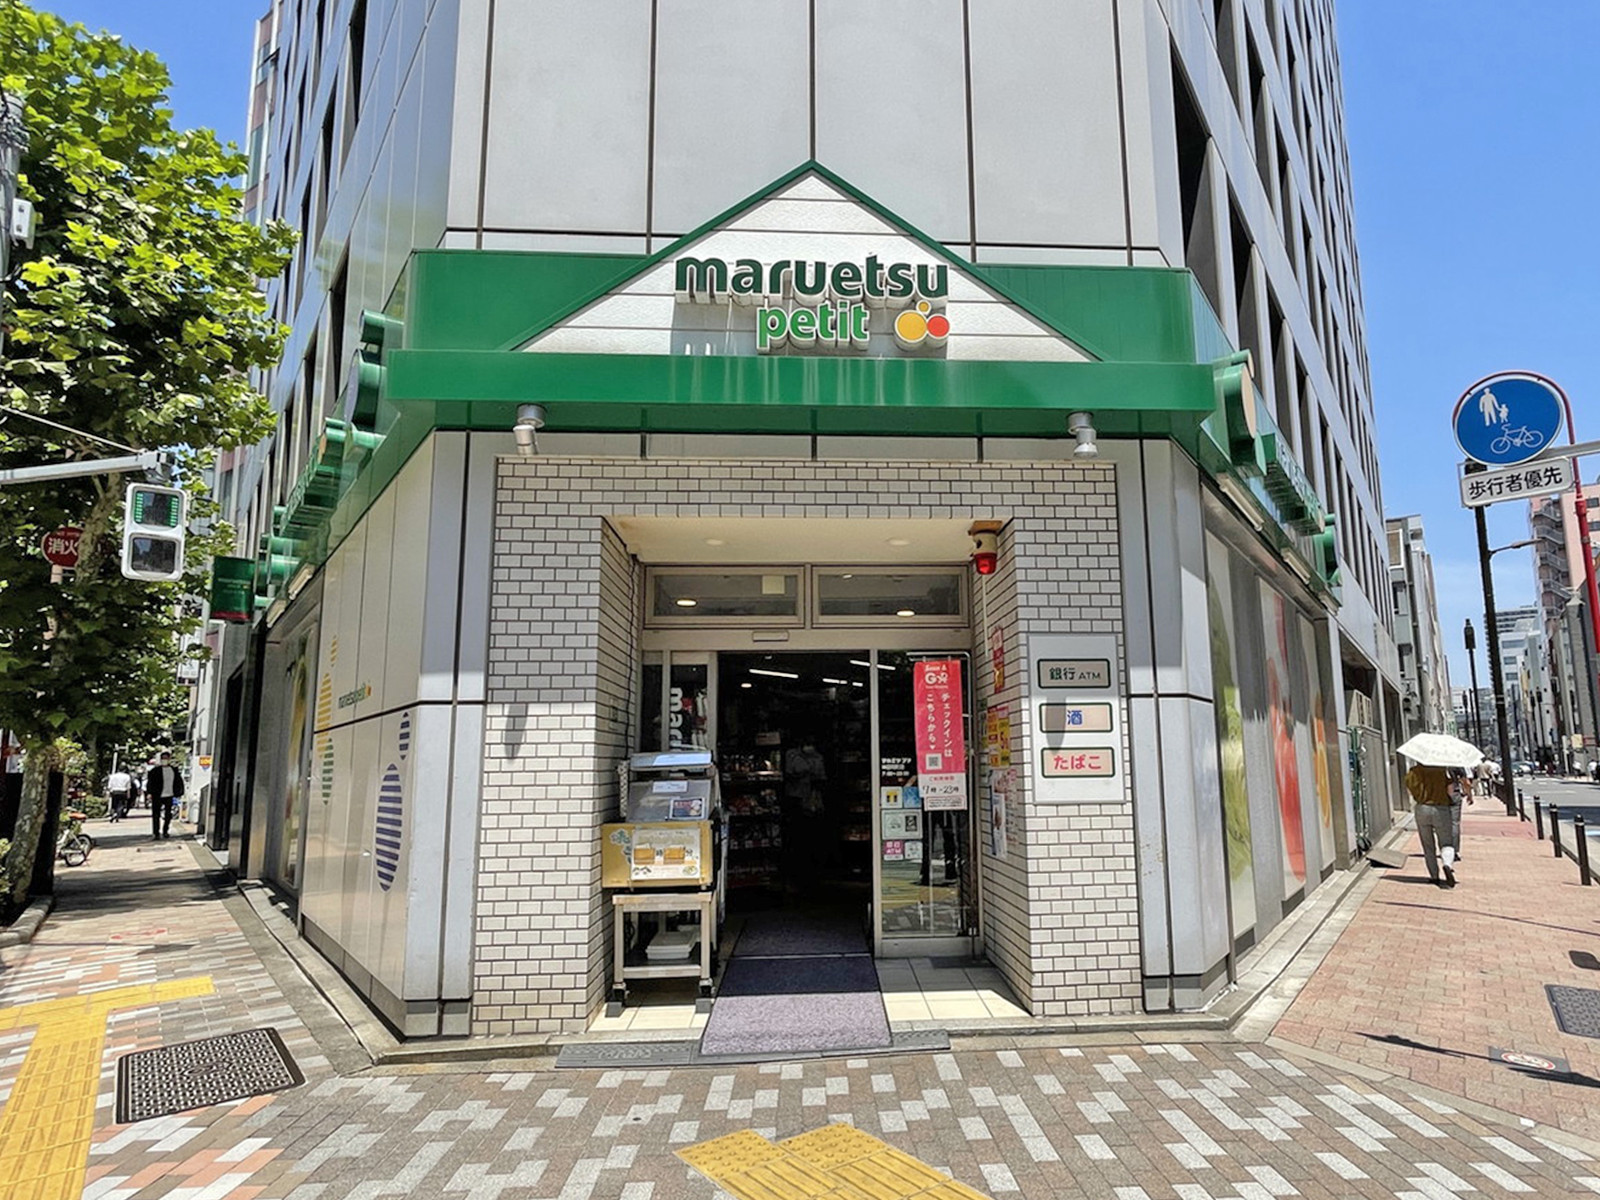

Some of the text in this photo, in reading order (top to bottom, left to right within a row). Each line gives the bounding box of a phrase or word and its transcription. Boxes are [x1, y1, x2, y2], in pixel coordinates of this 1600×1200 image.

[675, 254, 948, 298] maruetsu
[758, 301, 868, 349] petit
[1469, 466, 1563, 499] 歩行者優先
[48, 537, 80, 555] 消火
[1049, 667, 1101, 680] 銀行 ATM
[670, 687, 683, 748] mar
[926, 693, 937, 743] こちらから
[941, 692, 954, 757] チェックインは
[1067, 710, 1083, 725] 酒
[1053, 754, 1102, 770] たばこ
